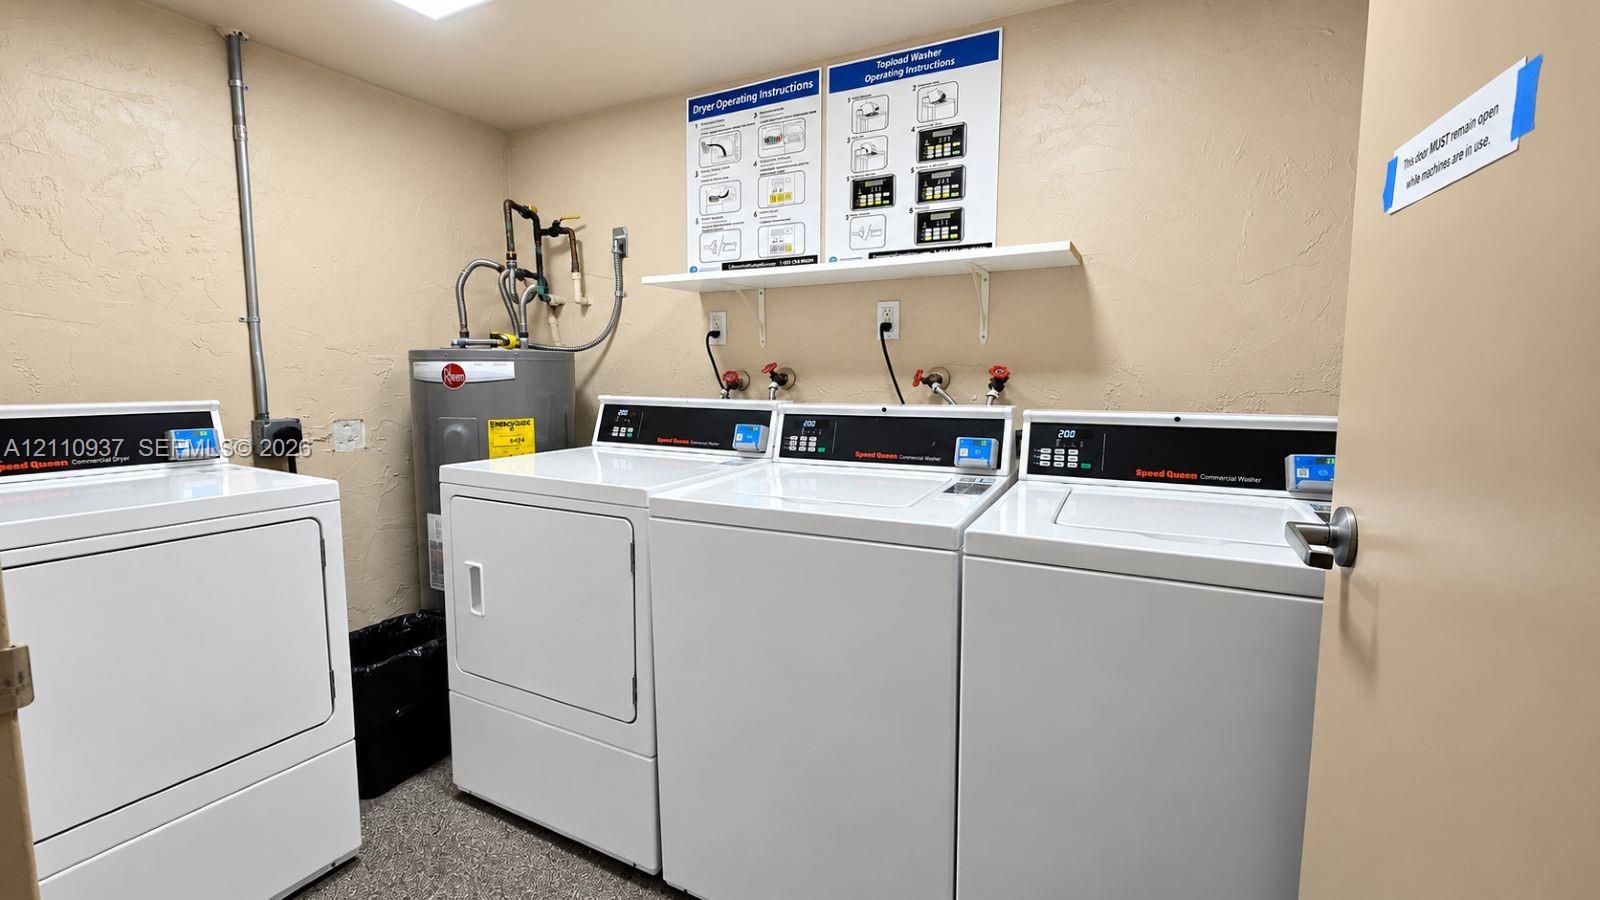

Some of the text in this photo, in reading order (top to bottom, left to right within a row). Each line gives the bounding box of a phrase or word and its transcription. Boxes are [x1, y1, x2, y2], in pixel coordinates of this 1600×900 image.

[876, 49, 942, 69] Topload Washer
[864, 58, 955, 84] Operating Instructions
[692, 80, 814, 115] Dryer Operating Instructions
[1403, 104, 1499, 169] This door MUST remain open
[1406, 136, 1491, 189] while machines are in use.
[443, 364, 465, 384] Rheem
[0, 455, 131, 473] peed Queen Commercial Dryer
[855, 451, 876, 459] Speed
[876, 452, 898, 460] Queen
[1135, 469, 1165, 478] Speed
[1166, 470, 1198, 480] Queen
[1199, 473, 1237, 482] Commercial
